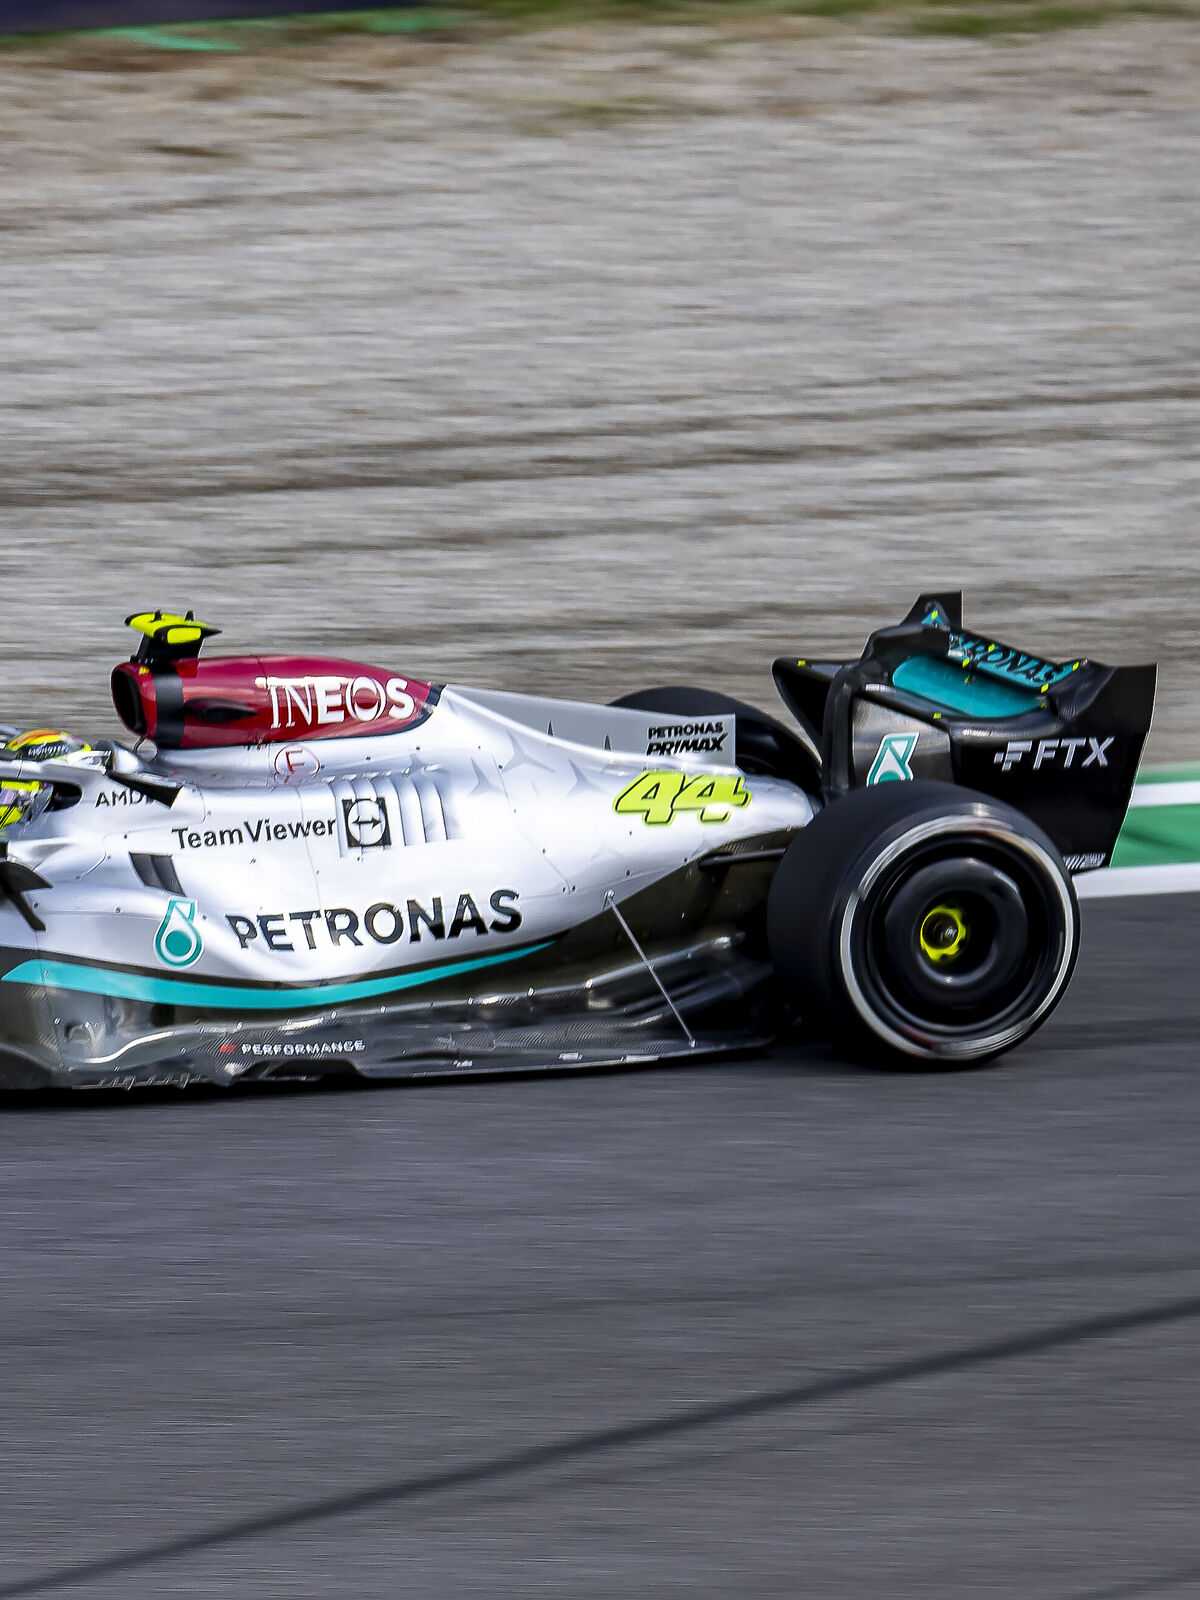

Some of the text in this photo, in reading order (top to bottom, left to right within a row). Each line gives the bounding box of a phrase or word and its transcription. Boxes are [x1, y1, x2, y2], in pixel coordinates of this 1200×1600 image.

[268, 676, 416, 729] INEOS
[646, 732, 729, 756] PRIMAX
[648, 721, 724, 740] PETRONAS
[1033, 736, 1115, 770] FTX
[613, 769, 752, 827] 44
[171, 818, 336, 849] TeamViewer
[225, 889, 523, 951] PETRONAS
[241, 1039, 366, 1055] PERFORMANCE
